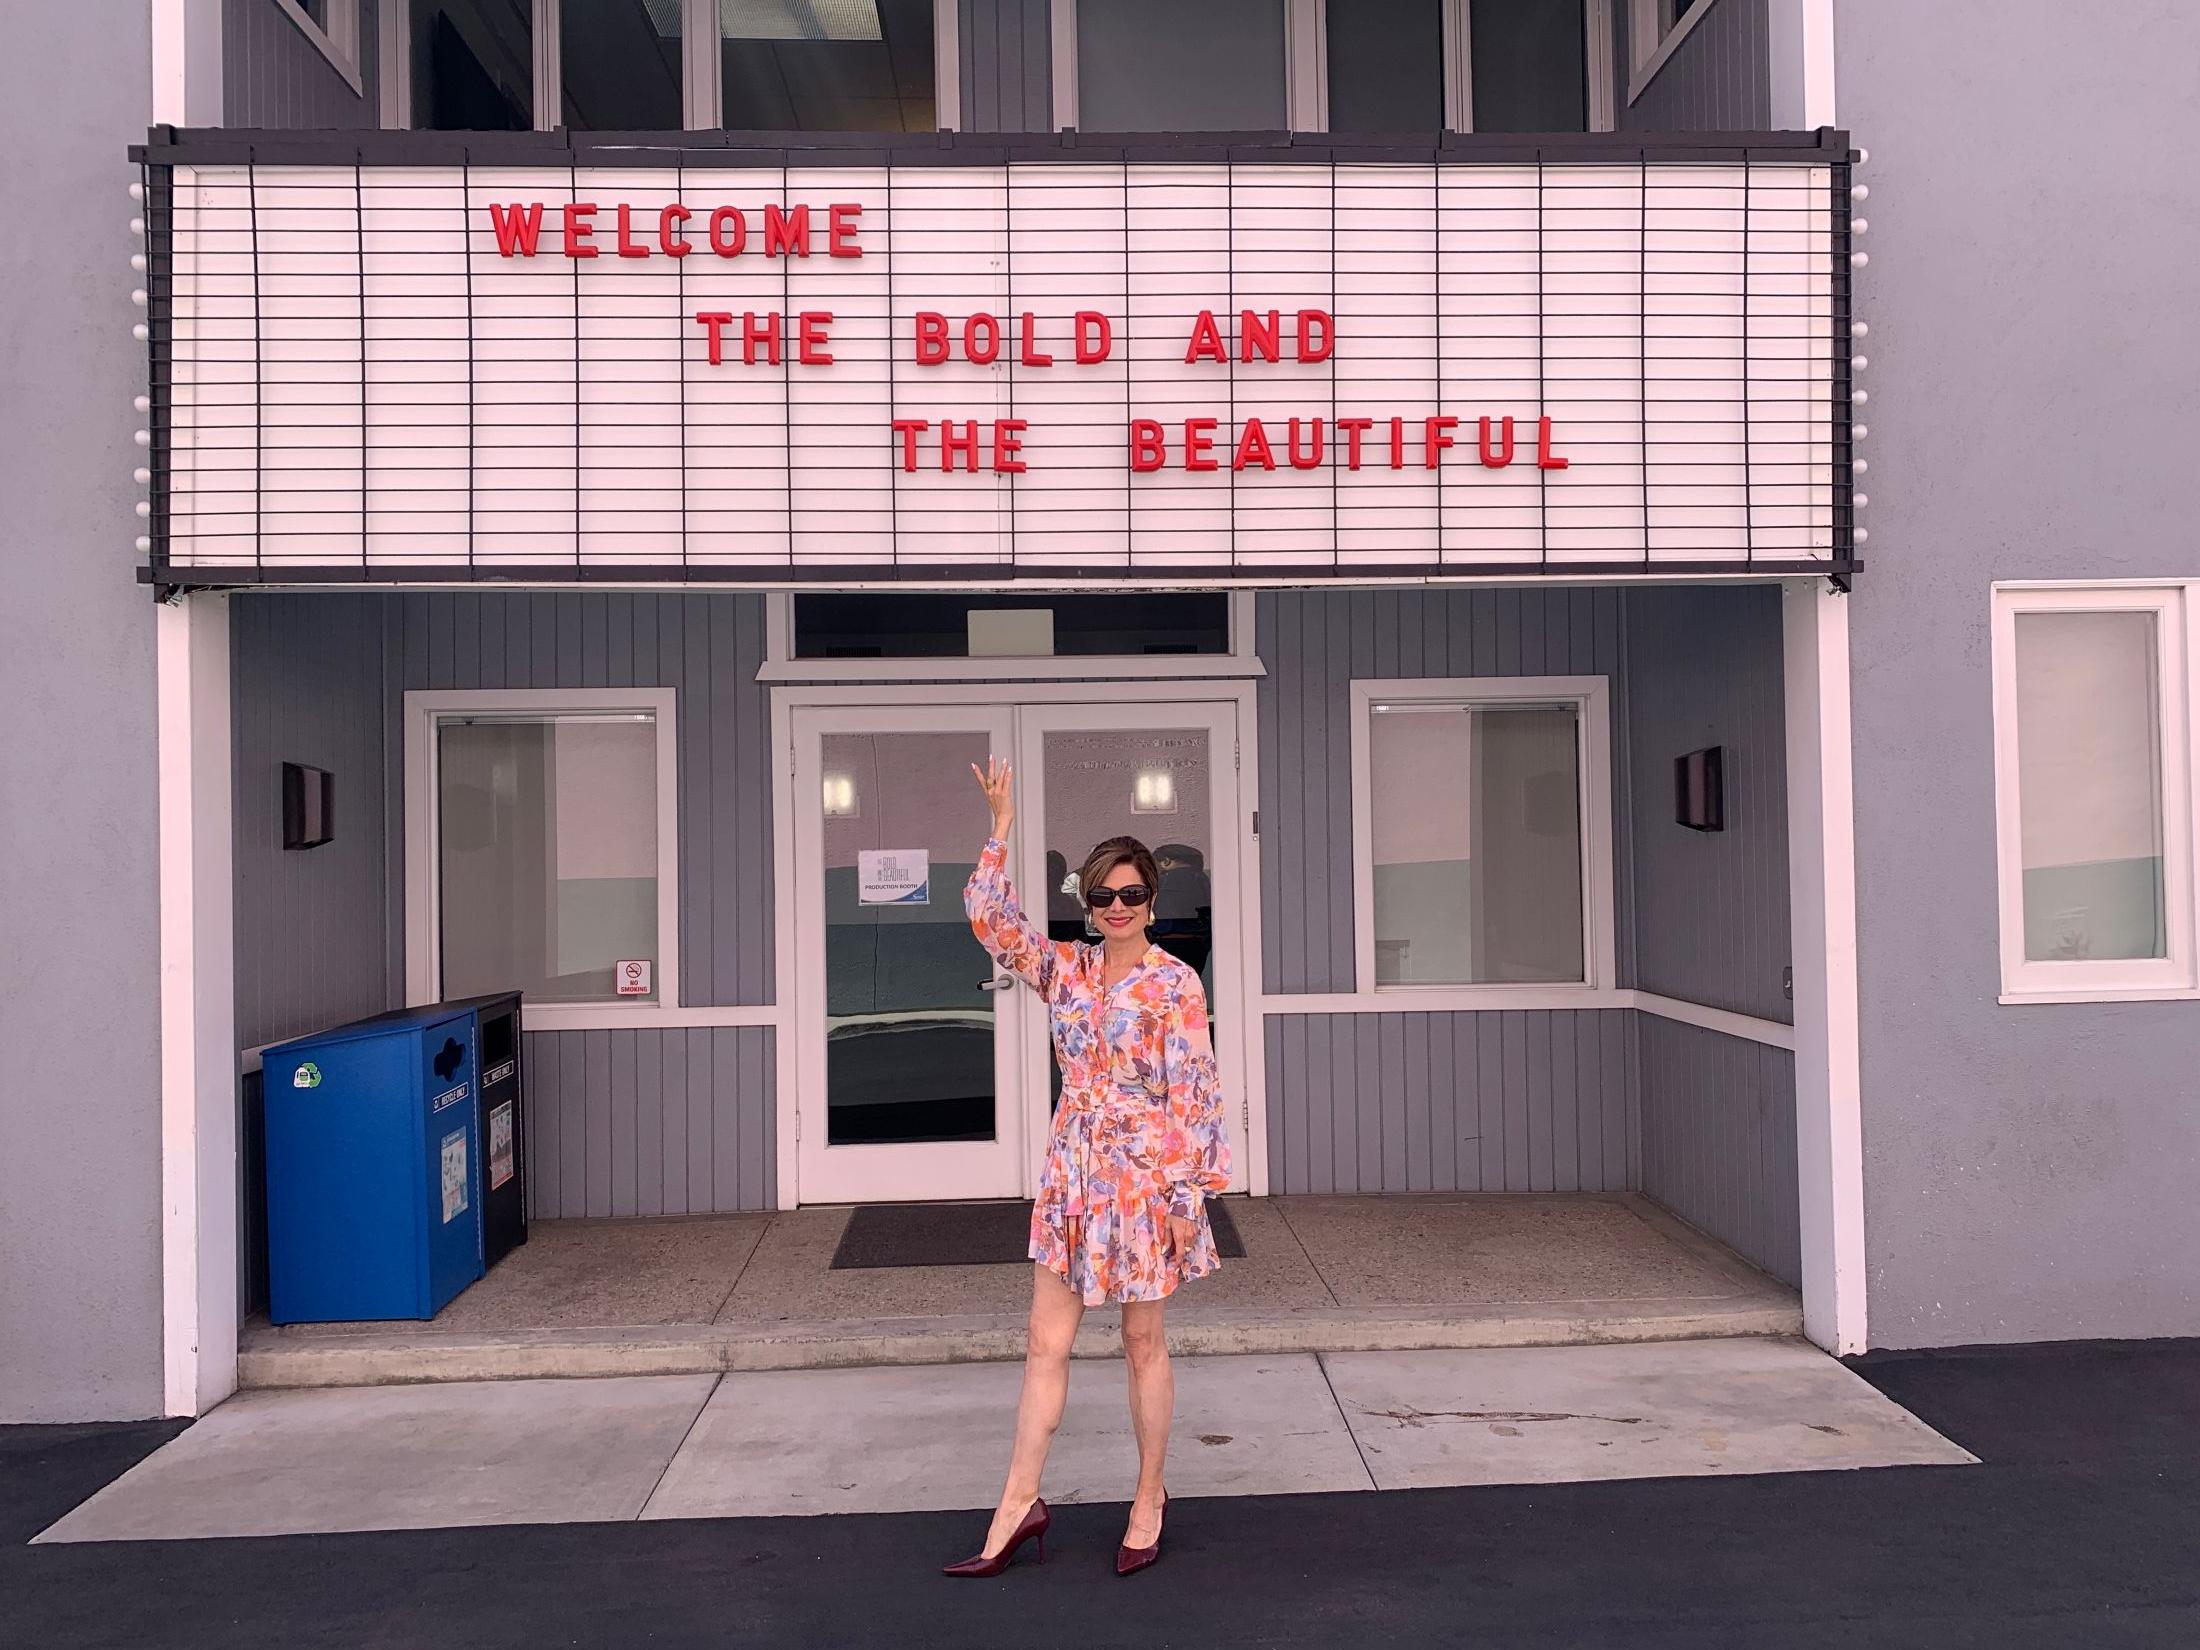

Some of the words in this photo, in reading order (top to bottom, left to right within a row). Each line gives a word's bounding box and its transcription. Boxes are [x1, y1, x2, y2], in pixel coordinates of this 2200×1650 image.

[489, 202, 864, 258] WELCOME
[695, 311, 835, 366] THE
[914, 311, 1112, 367] BOLD
[1184, 309, 1335, 365] AND
[891, 419, 1030, 474] THE
[1130, 415, 1570, 473] BEAUTIFUL
[441, 1091, 456, 1106] RECYCLE
